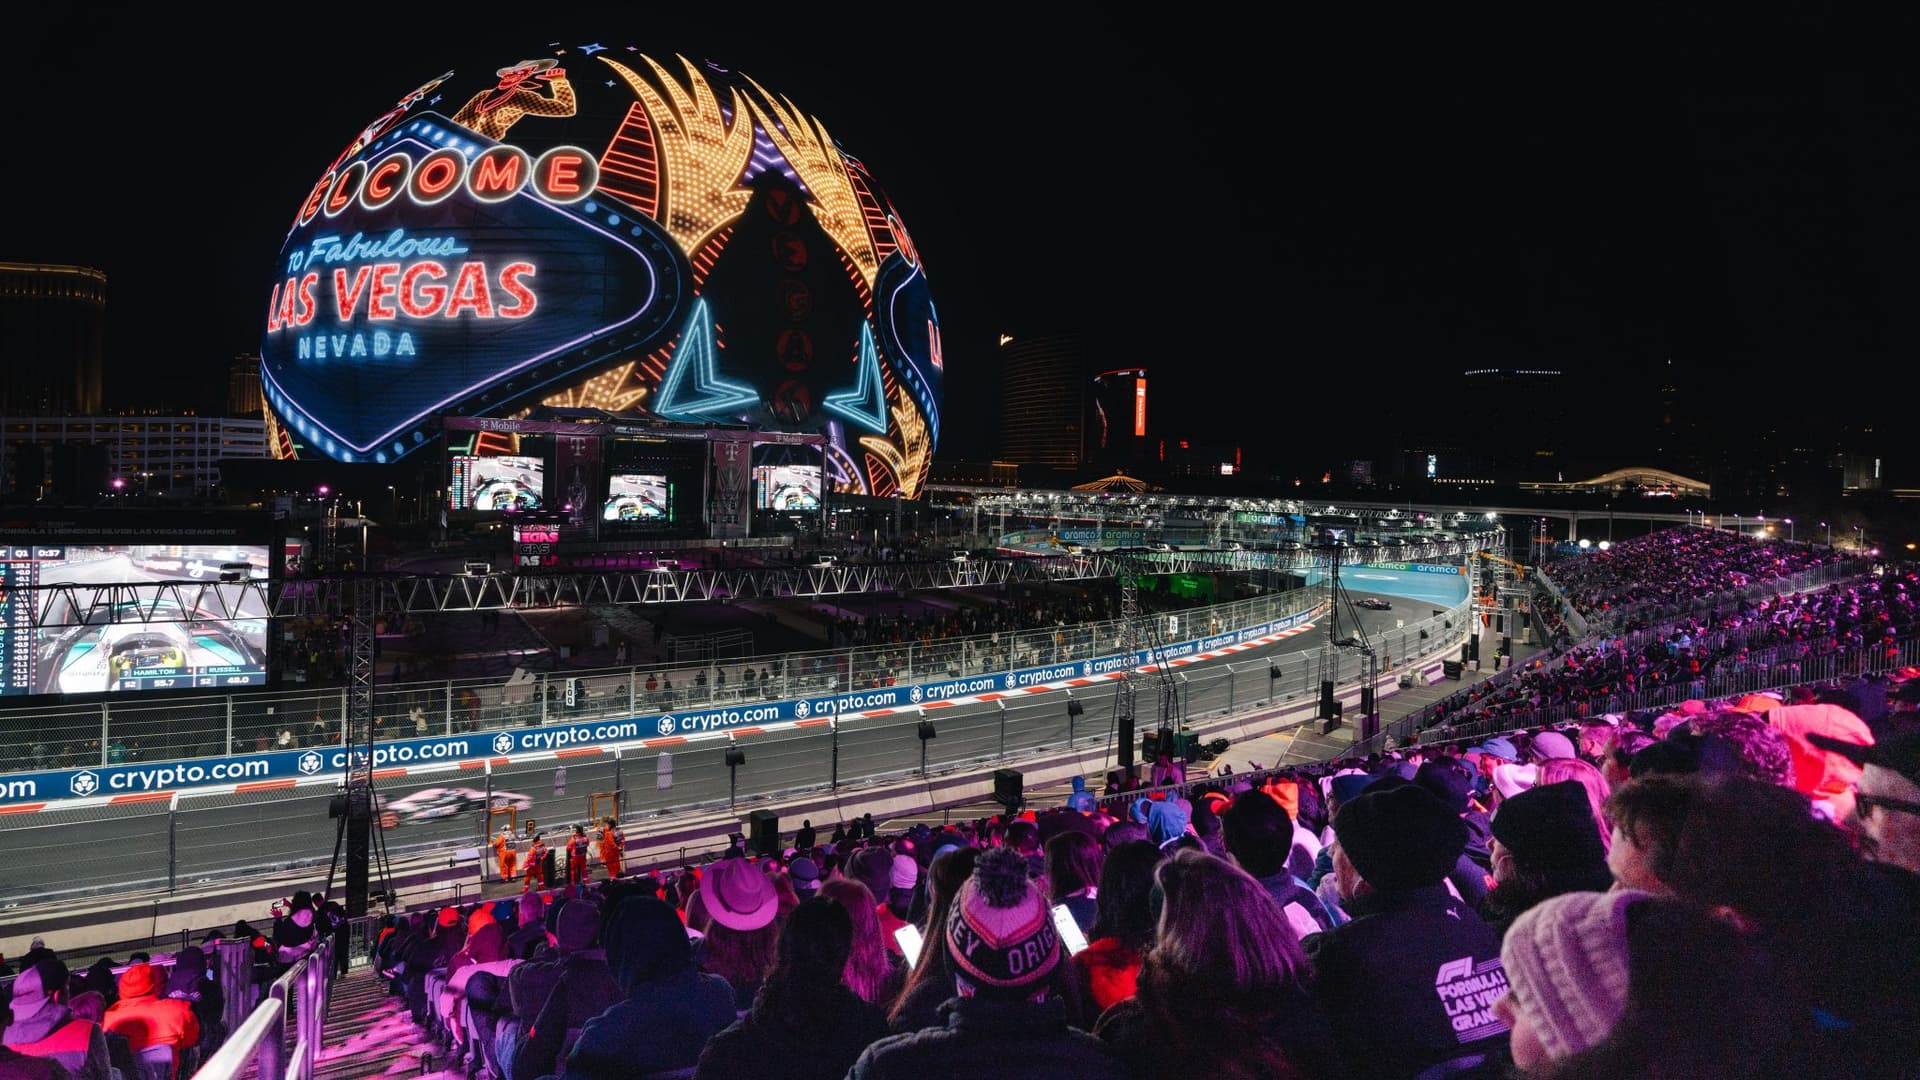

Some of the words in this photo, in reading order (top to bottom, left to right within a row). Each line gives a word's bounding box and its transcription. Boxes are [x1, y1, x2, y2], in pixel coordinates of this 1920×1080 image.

[300, 155, 582, 216] ELCOME
[288, 250, 301, 272] TO
[305, 229, 468, 270] Fabulous
[267, 273, 318, 333] LAS
[334, 261, 538, 321] VEGAS
[299, 331, 415, 359] NEVADA
[1417, 564, 1458, 574] aramco
[1156, 644, 1192, 660] crypto.com
[1204, 635, 1234, 649] crypto.com
[926, 678, 994, 699] crypto.com
[1019, 665, 1075, 685] crypto.com
[815, 690, 896, 713] crypto.com
[681, 705, 779, 731] crypto.com
[521, 722, 637, 751] crypto.com
[332, 740, 469, 768] crypto.com
[110, 757, 270, 790] crypto.com
[1008, 915, 1055, 974] ORIG
[1436, 972, 1500, 1001] FORMULA
[1444, 995, 1477, 1016] LAS
[1452, 1007, 1497, 1031] GRAN
